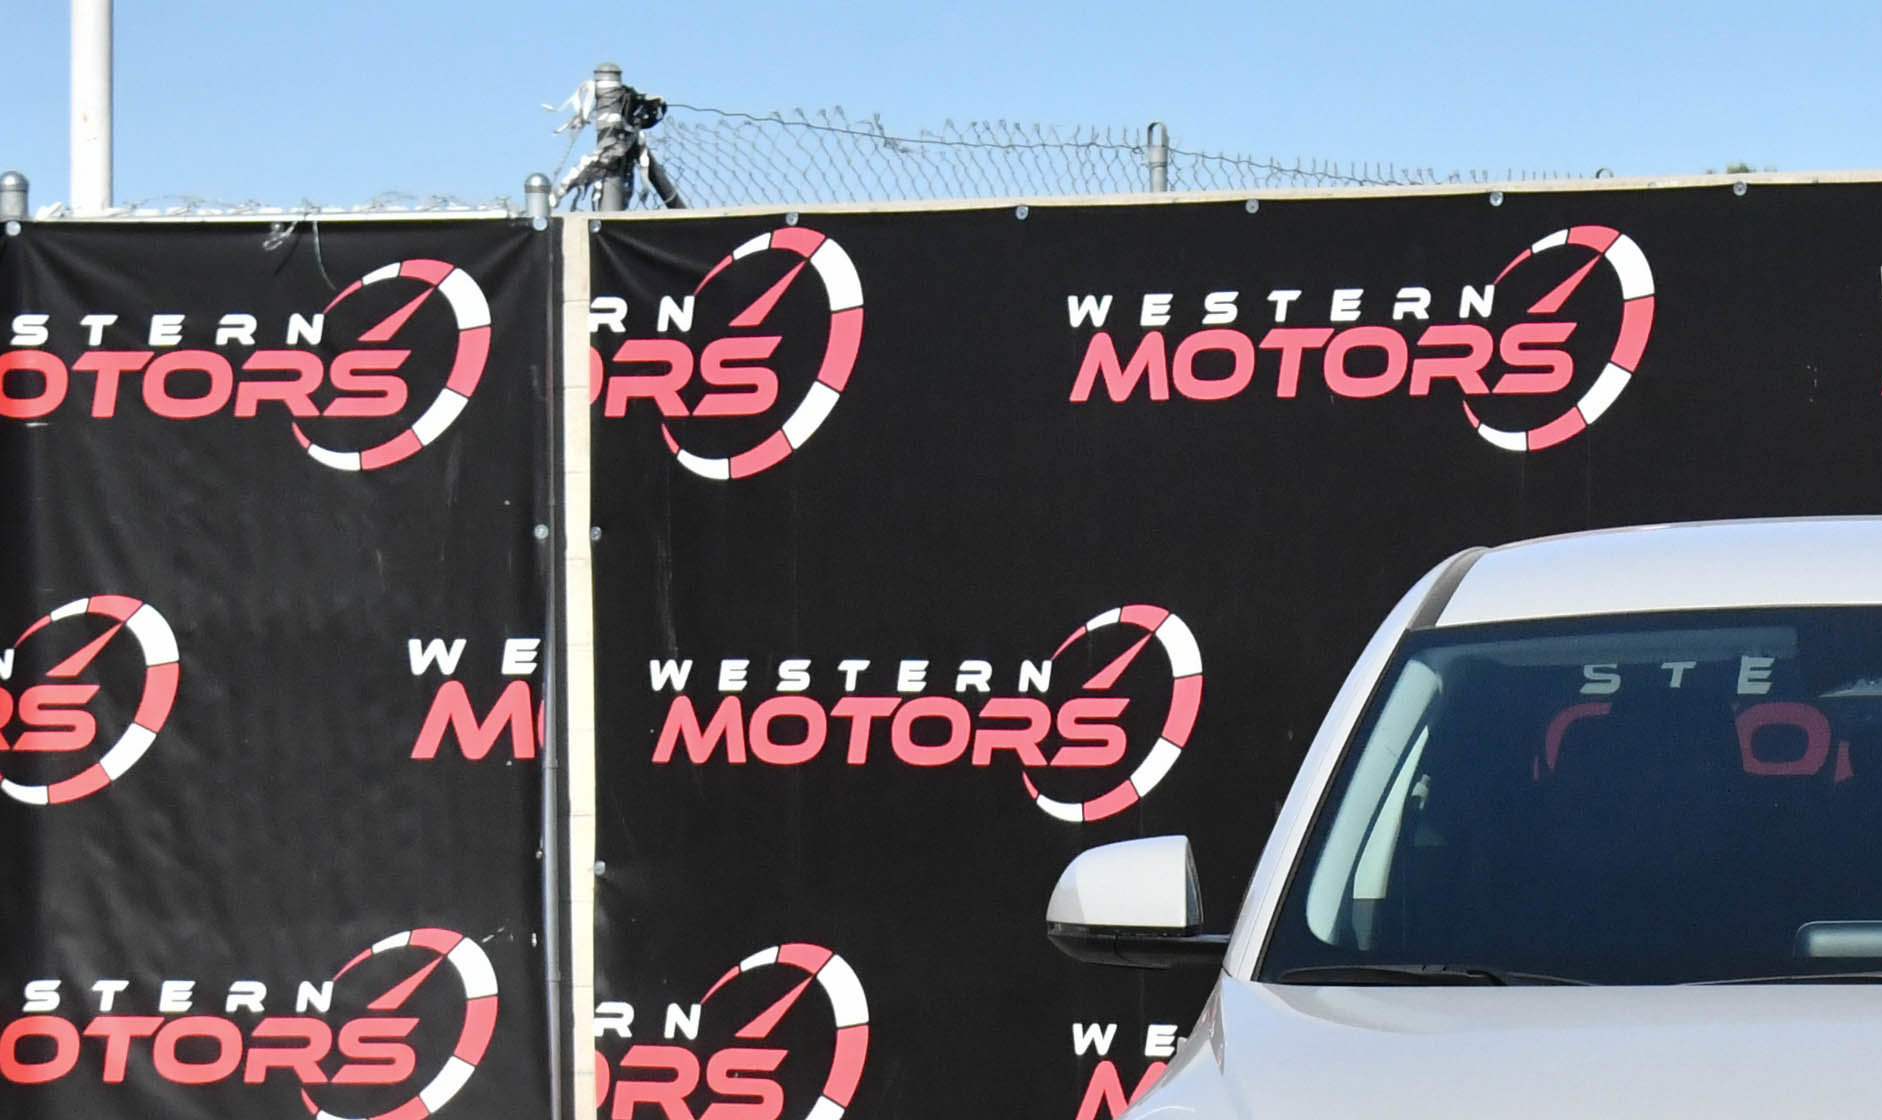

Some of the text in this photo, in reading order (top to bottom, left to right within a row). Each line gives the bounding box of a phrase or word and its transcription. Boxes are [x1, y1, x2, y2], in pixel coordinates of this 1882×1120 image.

[10, 313, 324, 346] STERN
[1068, 284, 1495, 327] WESTERN
[0, 349, 411, 419] OTORS
[590, 336, 783, 418] RS
[1069, 322, 1577, 402] MOTORS
[650, 660, 1053, 692] WESTERN
[410, 680, 545, 761] M
[651, 695, 1130, 767] MOTORS
[22, 979, 333, 1013] STERN
[0, 1015, 420, 1085] OTORS
